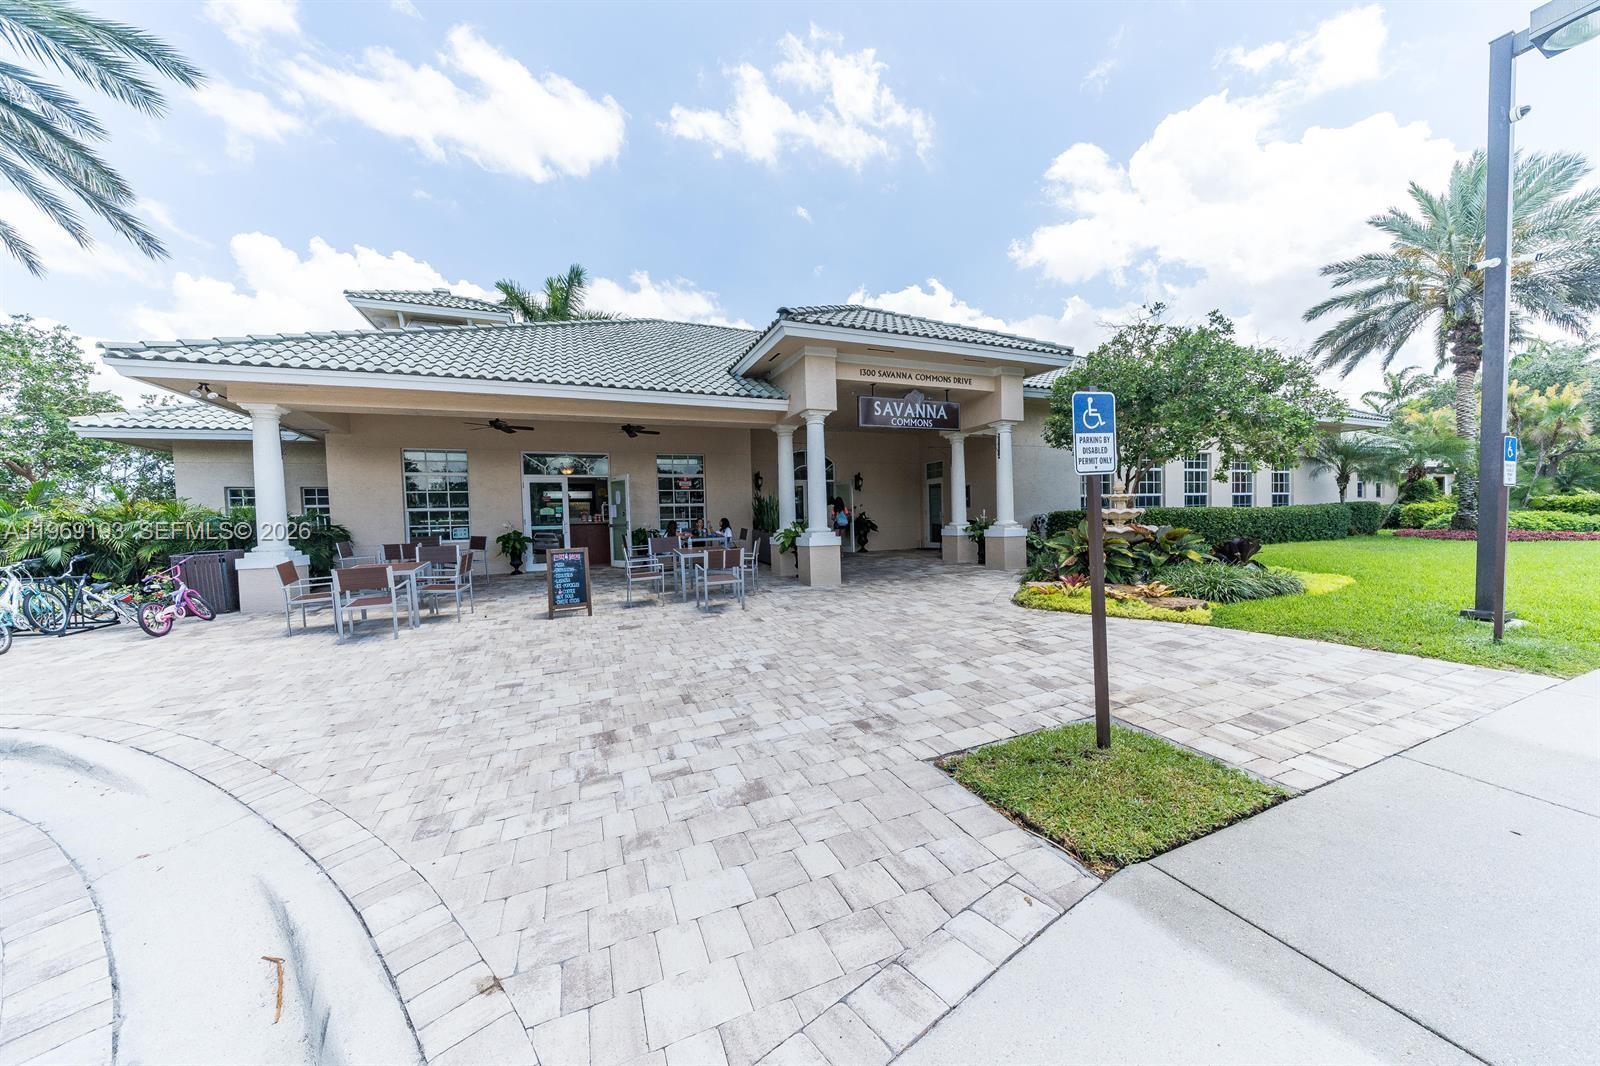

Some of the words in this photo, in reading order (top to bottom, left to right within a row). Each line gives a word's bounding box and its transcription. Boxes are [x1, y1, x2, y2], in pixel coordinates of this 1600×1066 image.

[860, 368, 876, 377] 1300
[878, 370, 912, 380] SAVANNA
[915, 374, 952, 384] COMMONS
[953, 377, 972, 386] DRIVE
[874, 400, 948, 420] SAVANNA
[891, 418, 933, 427] COMMONS
[1082, 446, 1108, 454] DISABLED
[1079, 457, 1098, 465] PERMIT
[1100, 457, 1112, 465] ONLY
